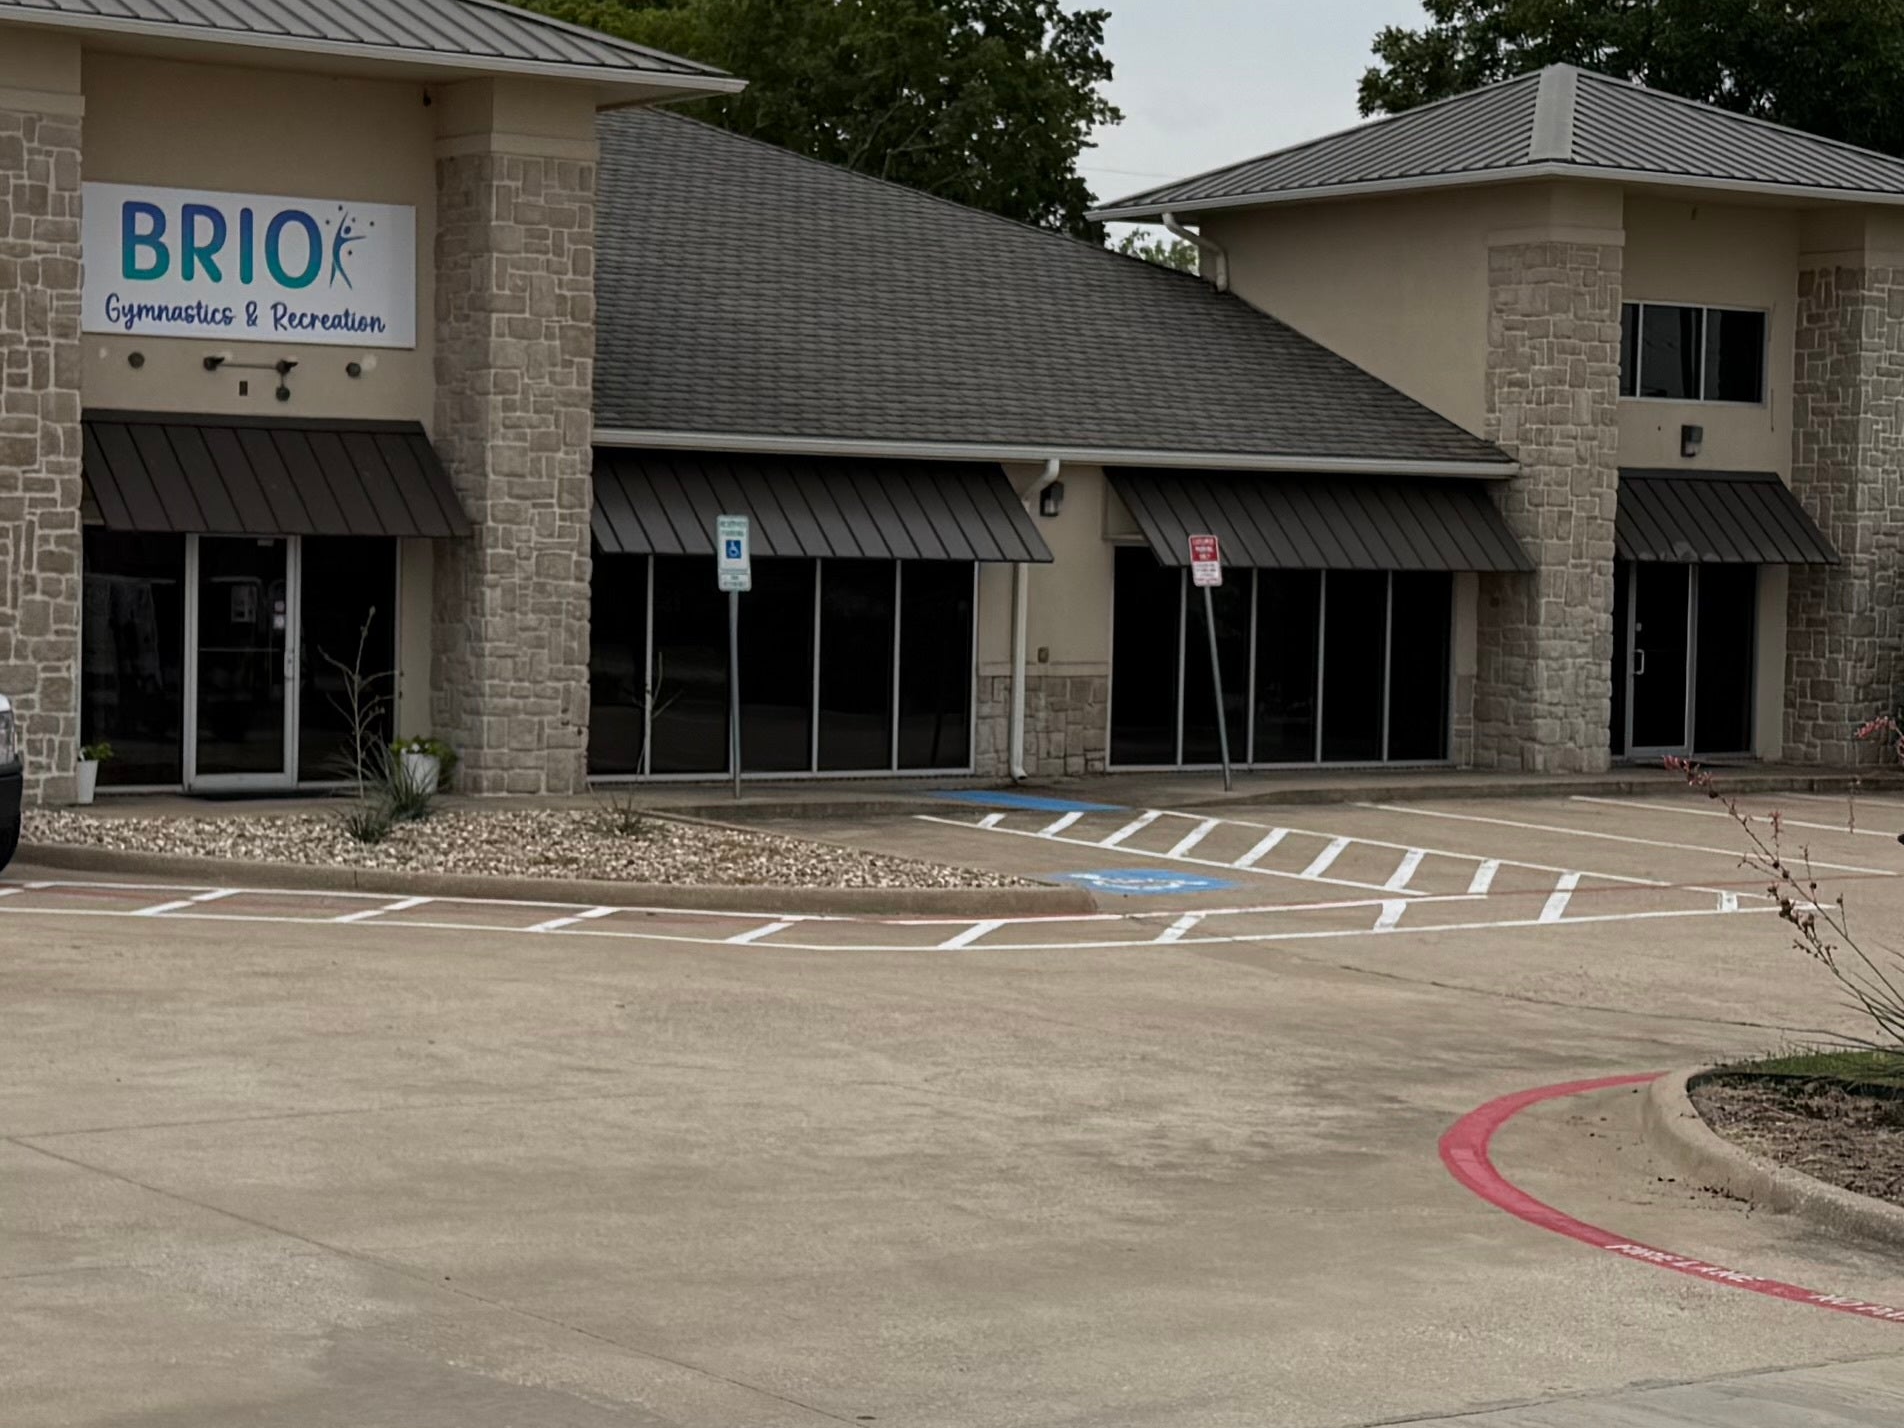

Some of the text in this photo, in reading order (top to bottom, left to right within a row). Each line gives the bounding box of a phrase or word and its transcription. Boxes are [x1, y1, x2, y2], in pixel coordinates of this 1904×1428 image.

[122, 201, 323, 289] BRIO
[105, 293, 386, 333] Gymnastics & Recreation
